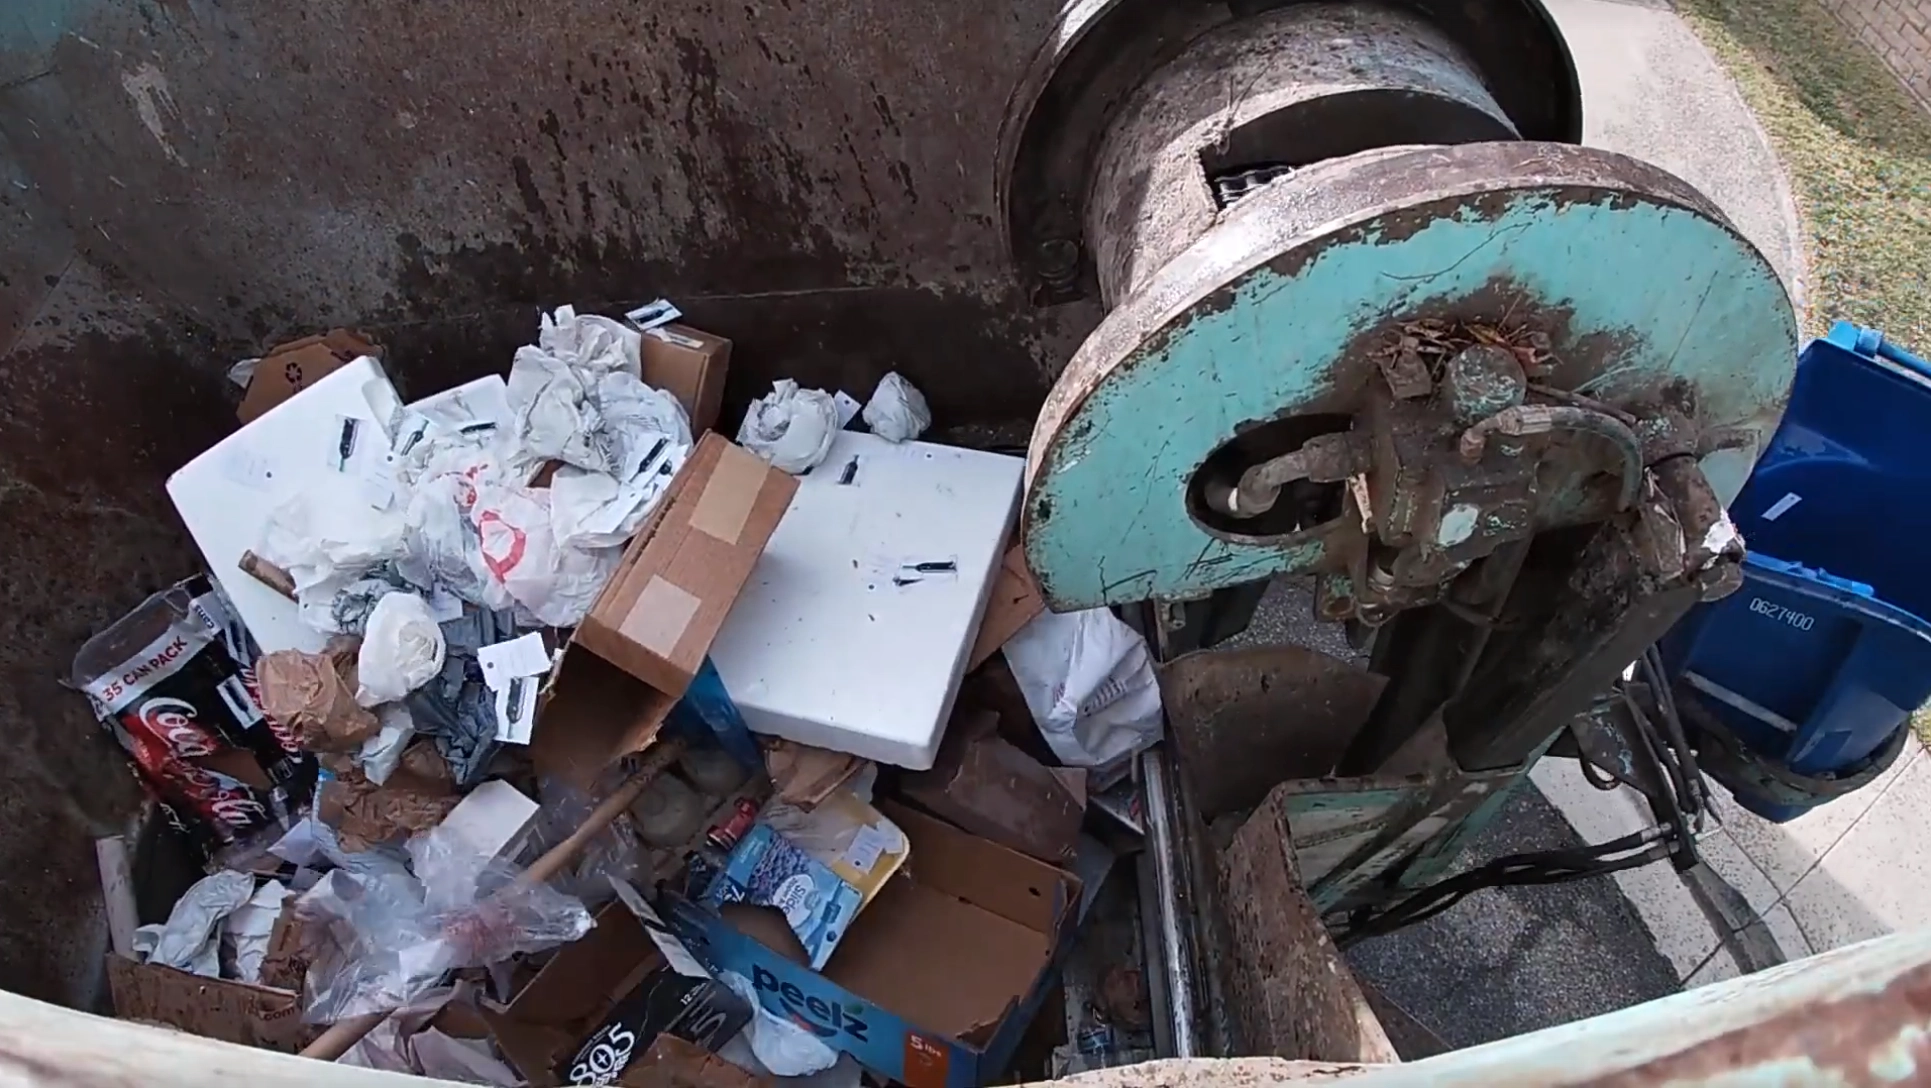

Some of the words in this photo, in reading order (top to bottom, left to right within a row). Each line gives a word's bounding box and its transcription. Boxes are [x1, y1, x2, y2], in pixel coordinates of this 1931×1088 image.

[1749, 597, 1815, 631] 0627400
[102, 680, 123, 702] 35
[123, 664, 152, 686] CAN
[149, 635, 188, 669] PACK
[751, 963, 869, 1043] peelz
[569, 1021, 635, 1087] 805
[910, 1035, 924, 1051] 5
